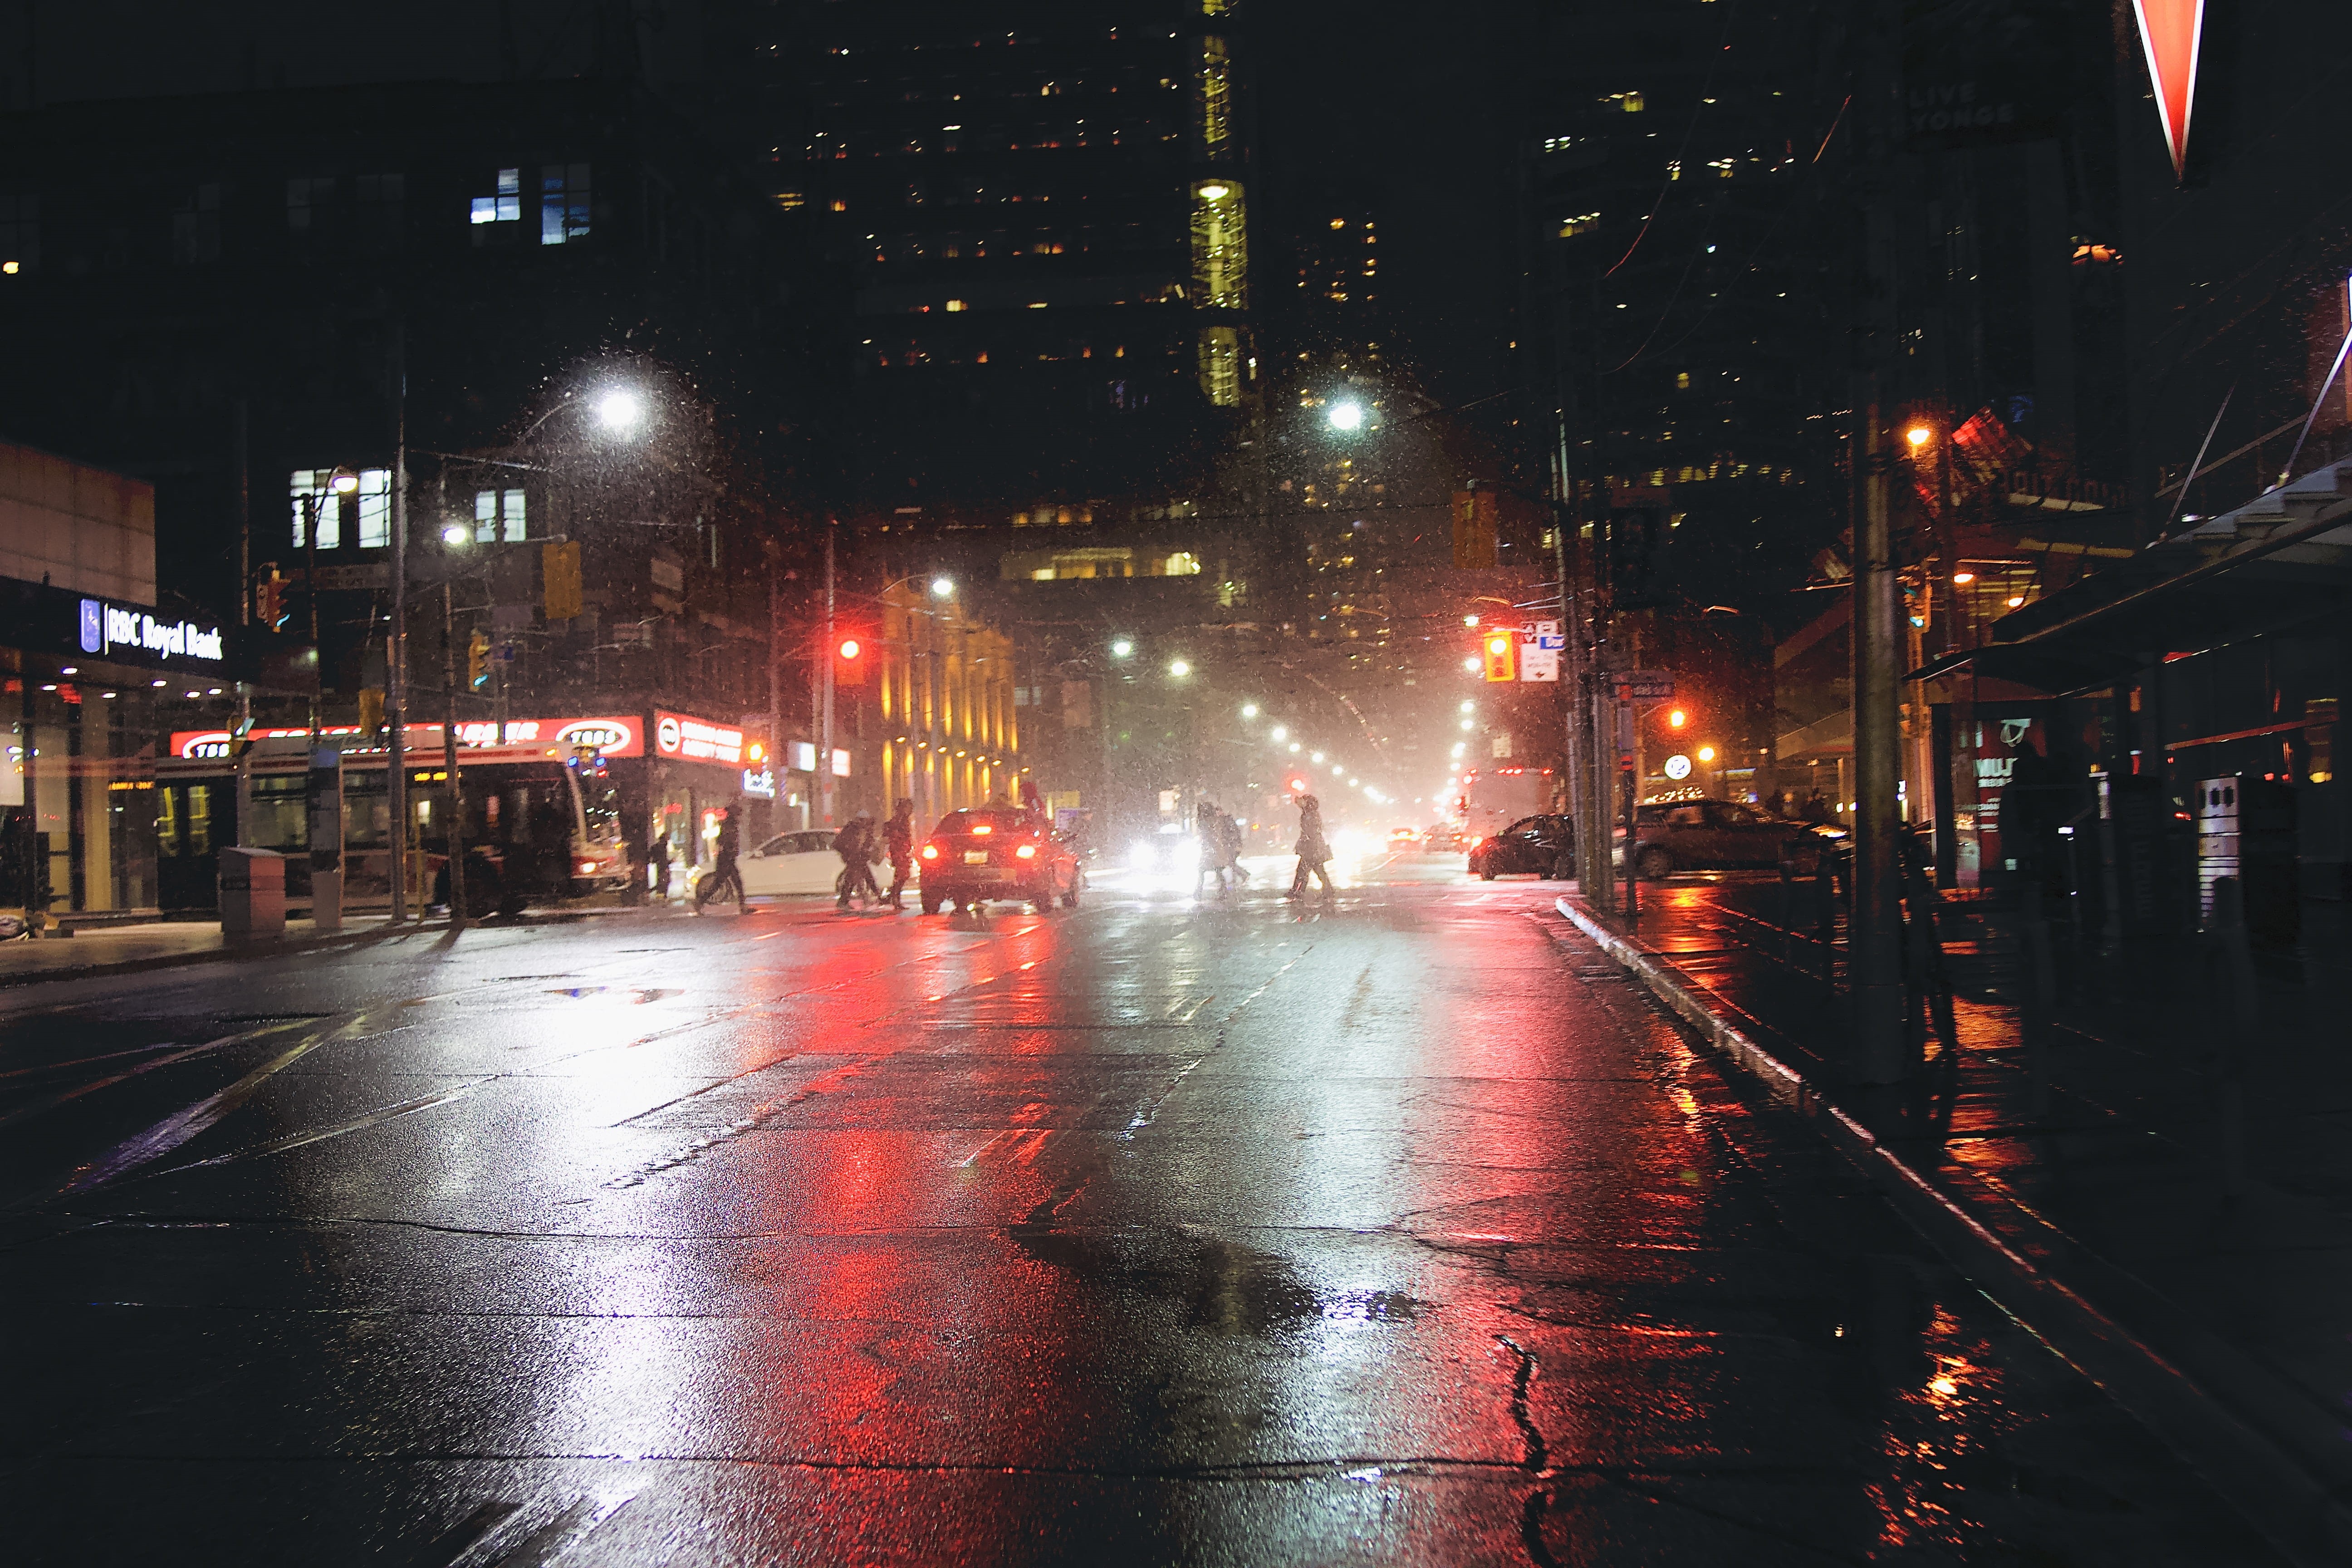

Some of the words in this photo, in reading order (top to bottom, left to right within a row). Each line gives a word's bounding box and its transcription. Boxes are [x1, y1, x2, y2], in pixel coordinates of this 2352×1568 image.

[1909, 82, 1976, 108] LIVE
[108, 608, 141, 647] RBC
[142, 614, 185, 660] Royal
[186, 623, 223, 661] Bank
